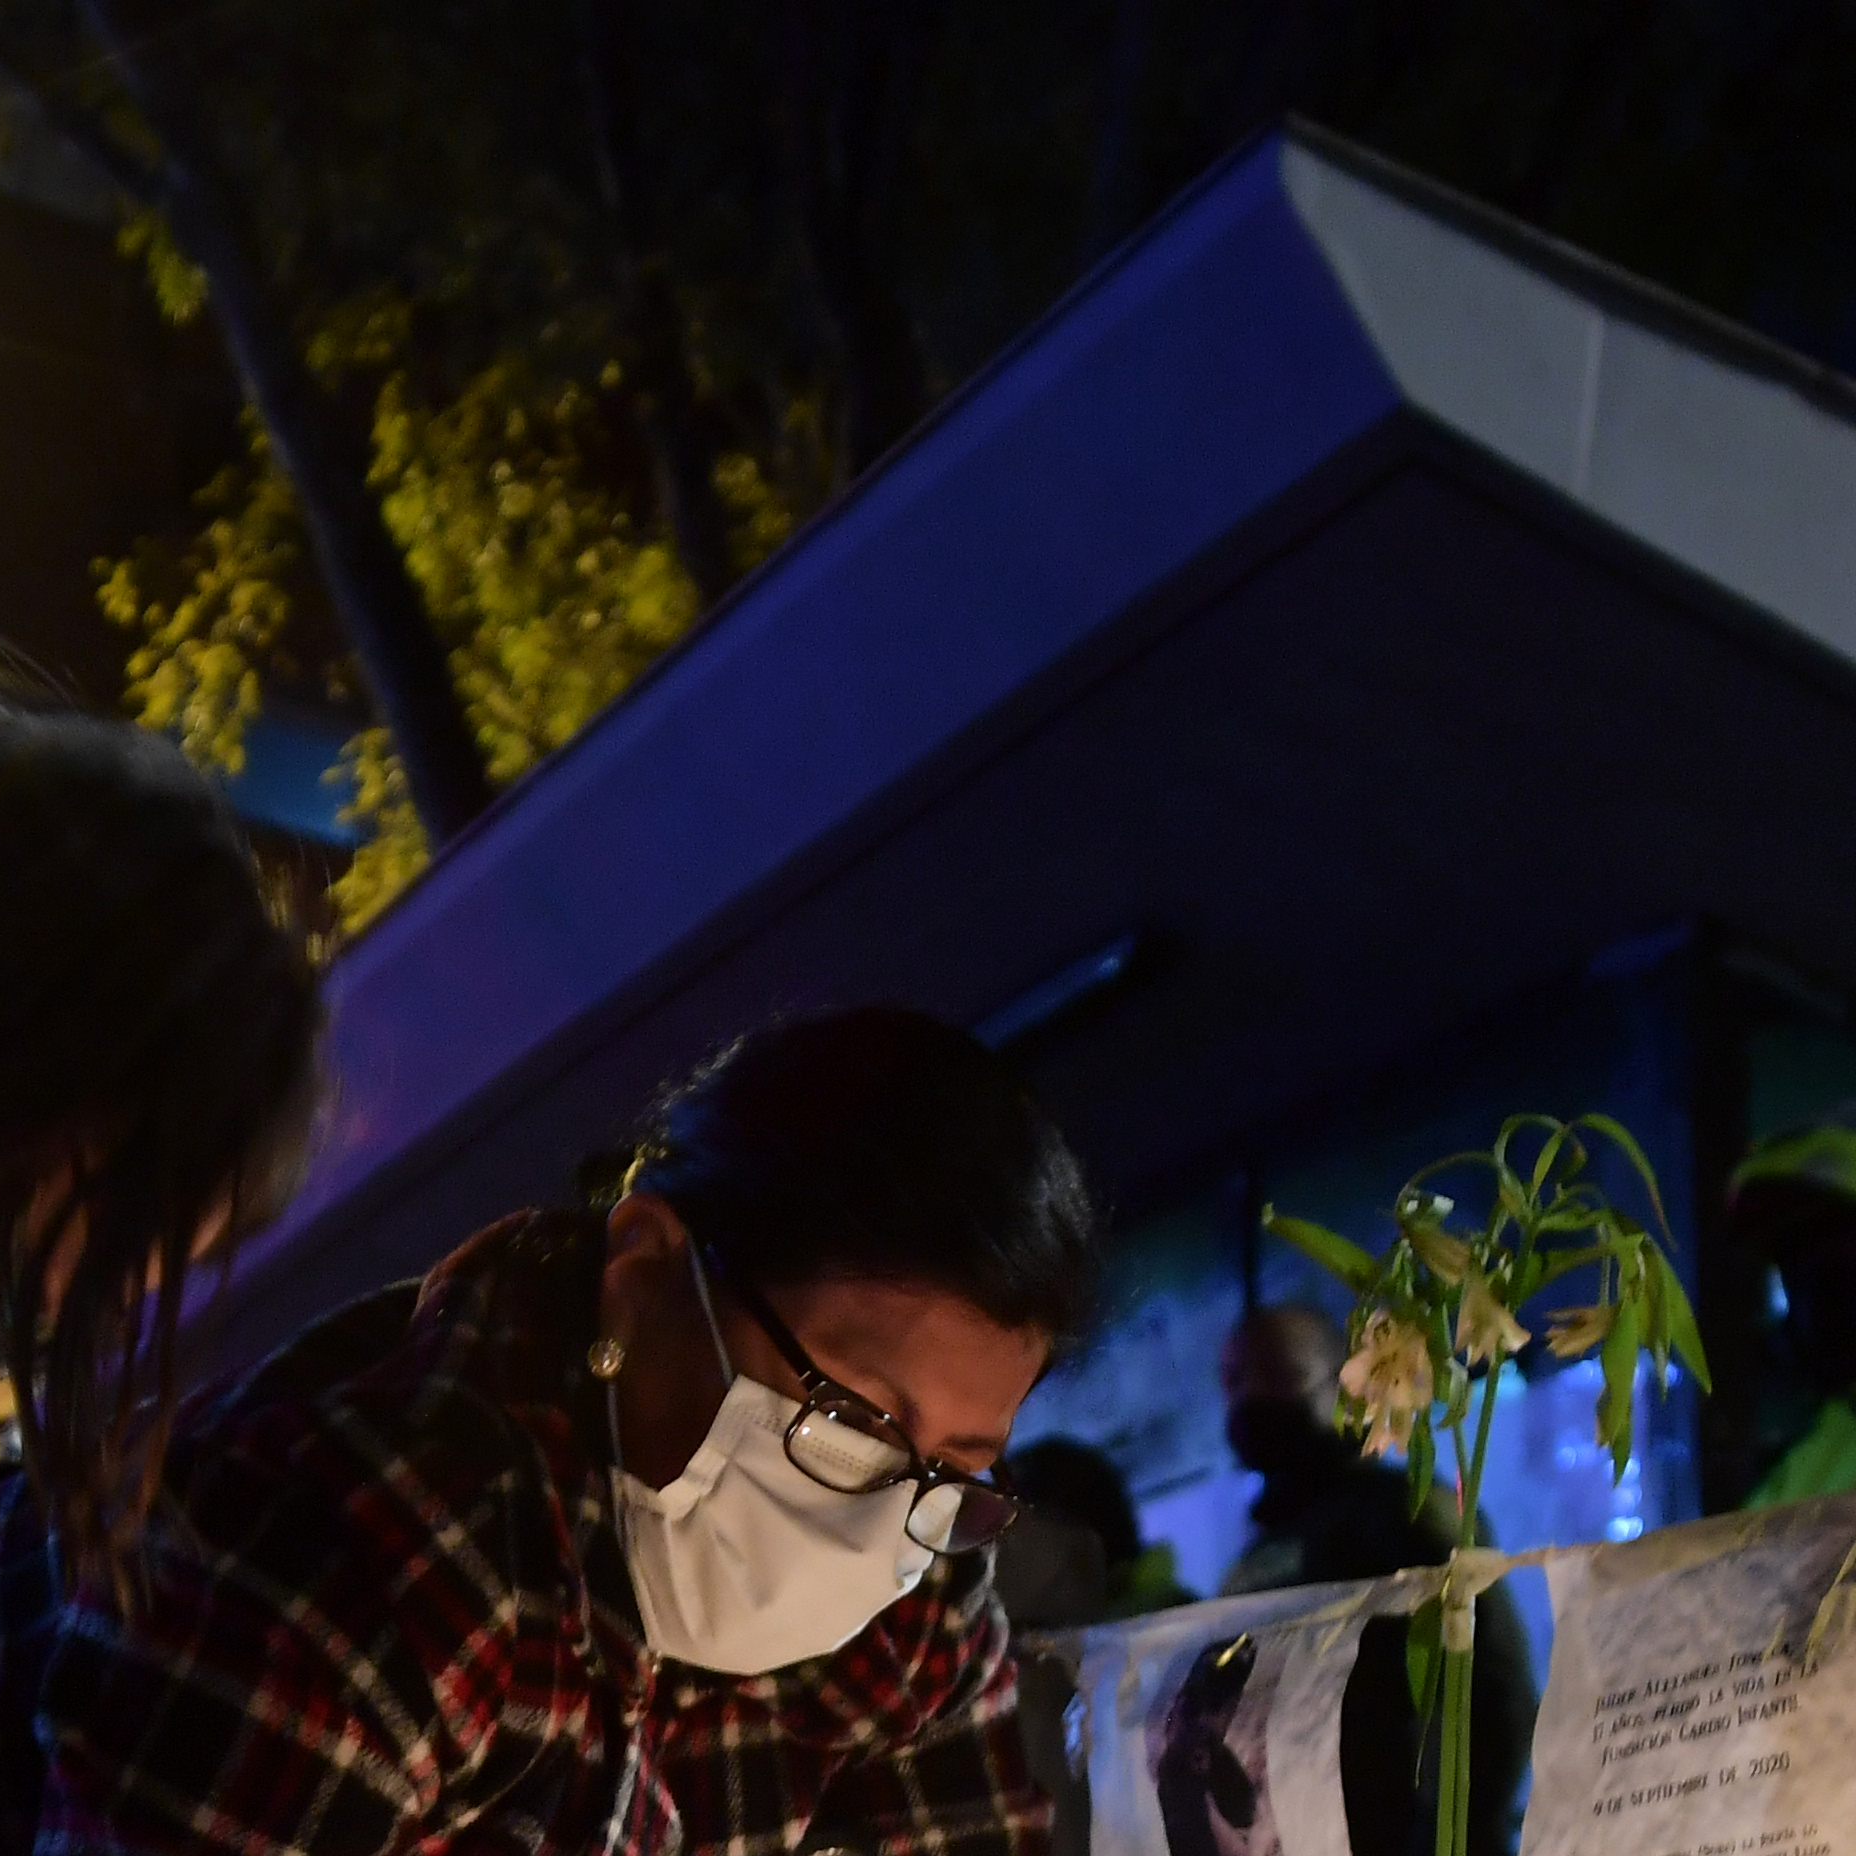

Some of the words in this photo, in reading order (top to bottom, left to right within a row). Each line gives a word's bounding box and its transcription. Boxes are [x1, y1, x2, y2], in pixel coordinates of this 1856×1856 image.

[1709, 1688, 1724, 1705] LA
[1733, 1674, 1765, 1699] VIDA
[1719, 1766, 1737, 1786] DE
[1749, 1751, 1790, 1778] 2020
